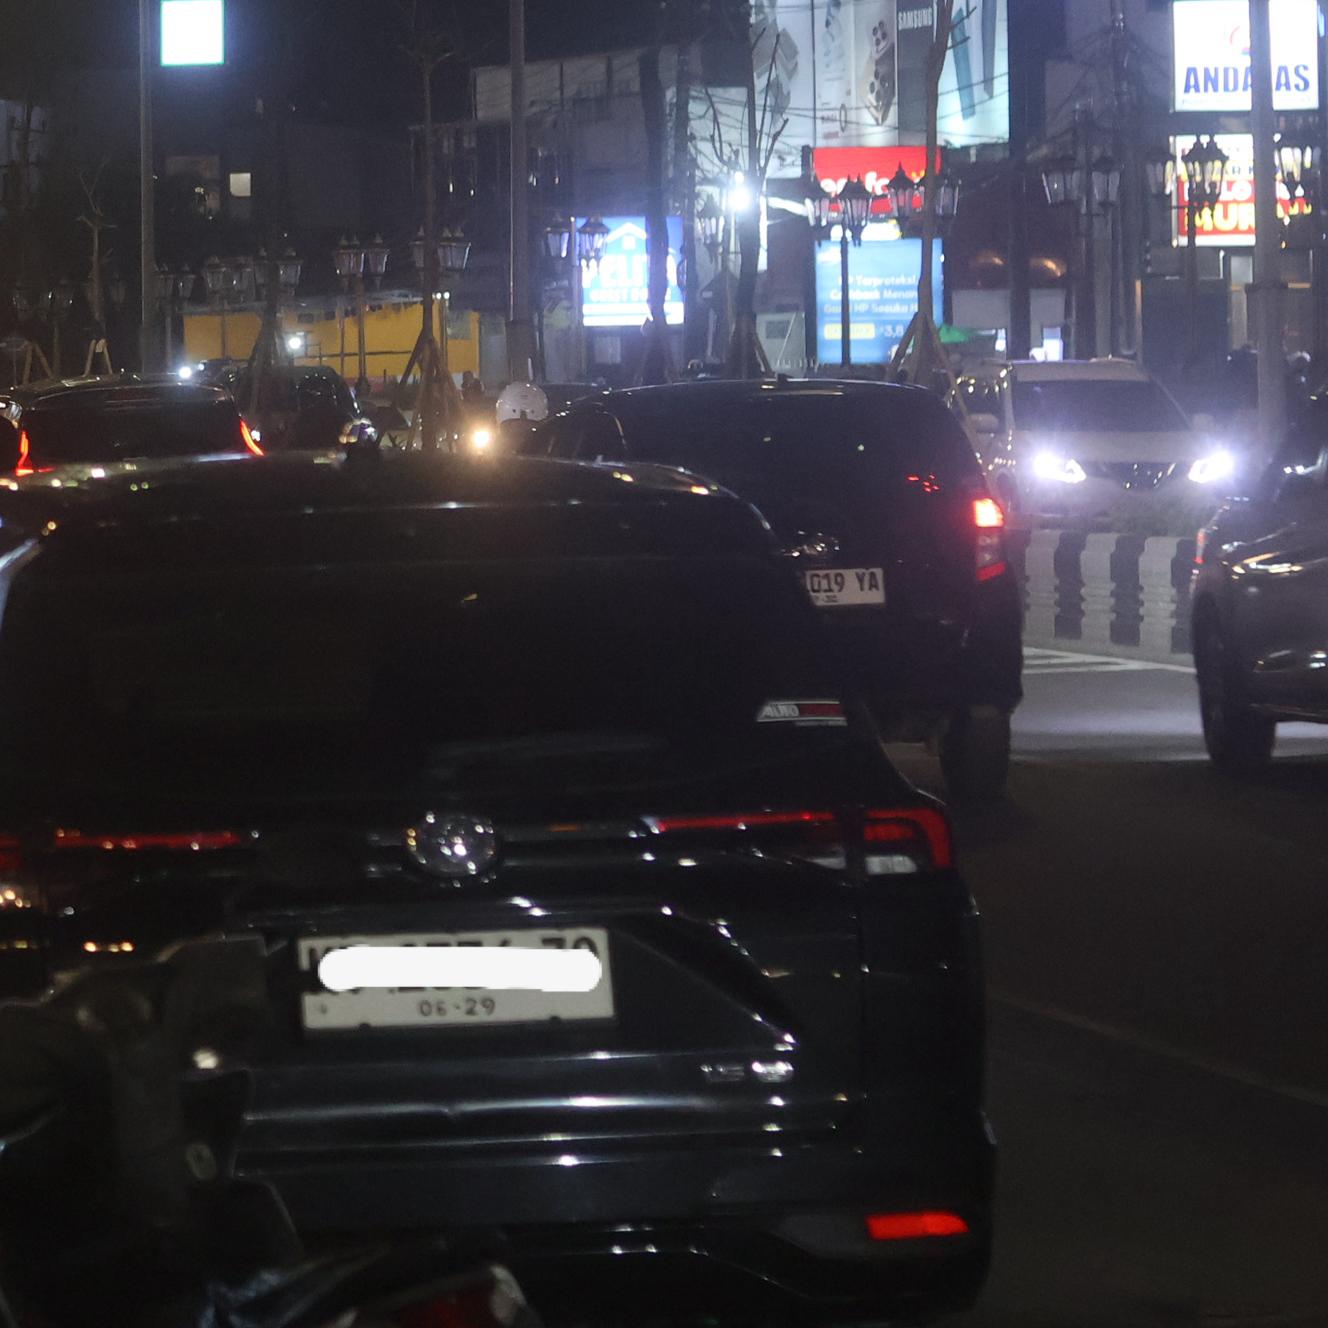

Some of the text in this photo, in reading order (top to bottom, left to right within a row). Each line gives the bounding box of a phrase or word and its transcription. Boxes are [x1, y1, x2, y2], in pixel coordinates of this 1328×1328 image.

[898, 9, 933, 30] SAMSUNG
[1183, 64, 1310, 94] ANDAAS
[581, 254, 677, 288] PELIA
[855, 570, 880, 592] YA
